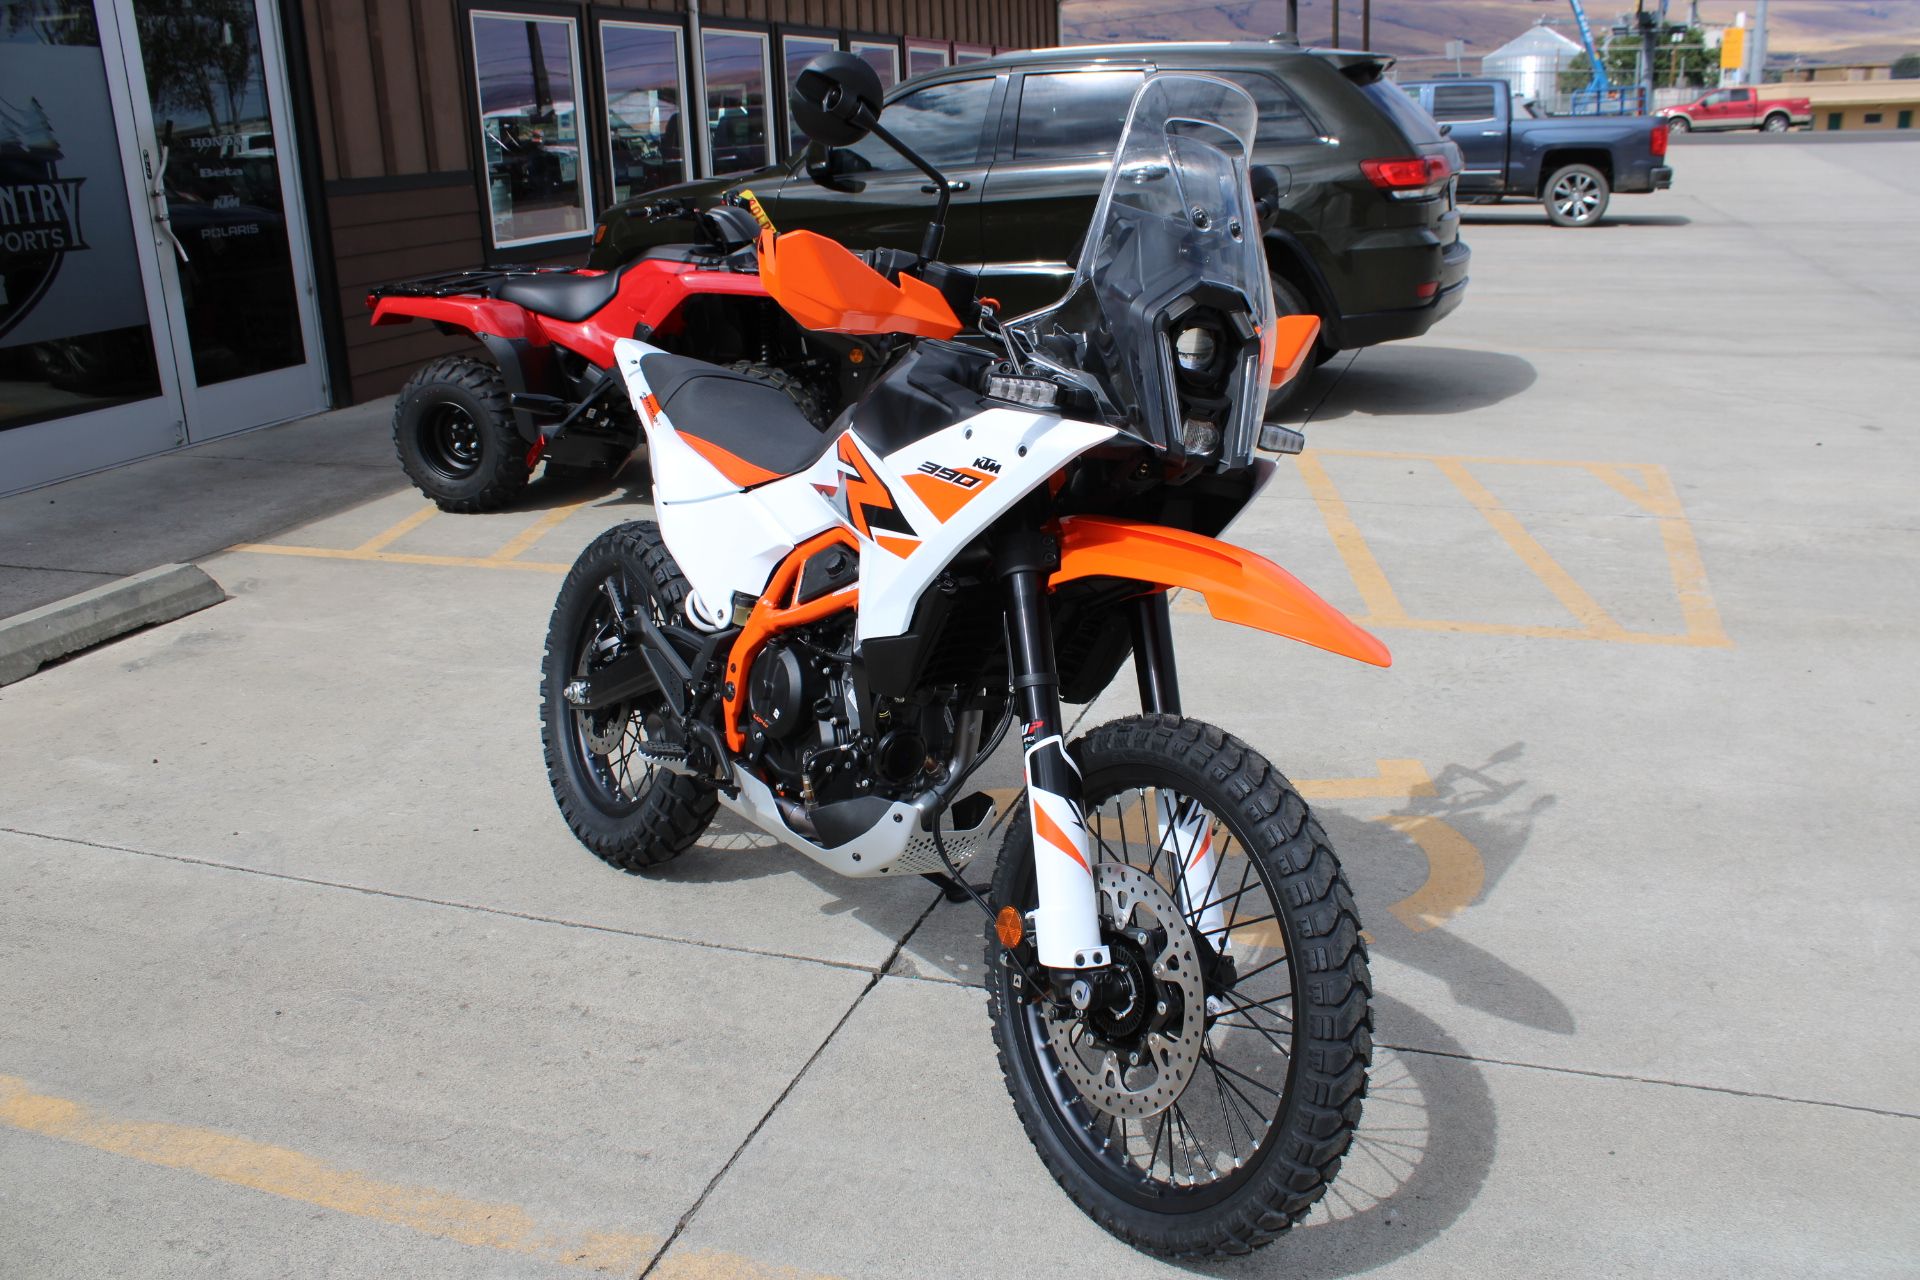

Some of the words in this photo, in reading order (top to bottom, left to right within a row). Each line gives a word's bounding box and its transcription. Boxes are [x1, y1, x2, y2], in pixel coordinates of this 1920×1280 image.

[190, 136, 243, 148] HONDA
[200, 168, 243, 178] Beta
[213, 195, 240, 209] KTM
[201, 224, 259, 239] POLARIS
[972, 456, 1002, 474] KTM
[917, 461, 982, 489] 390
